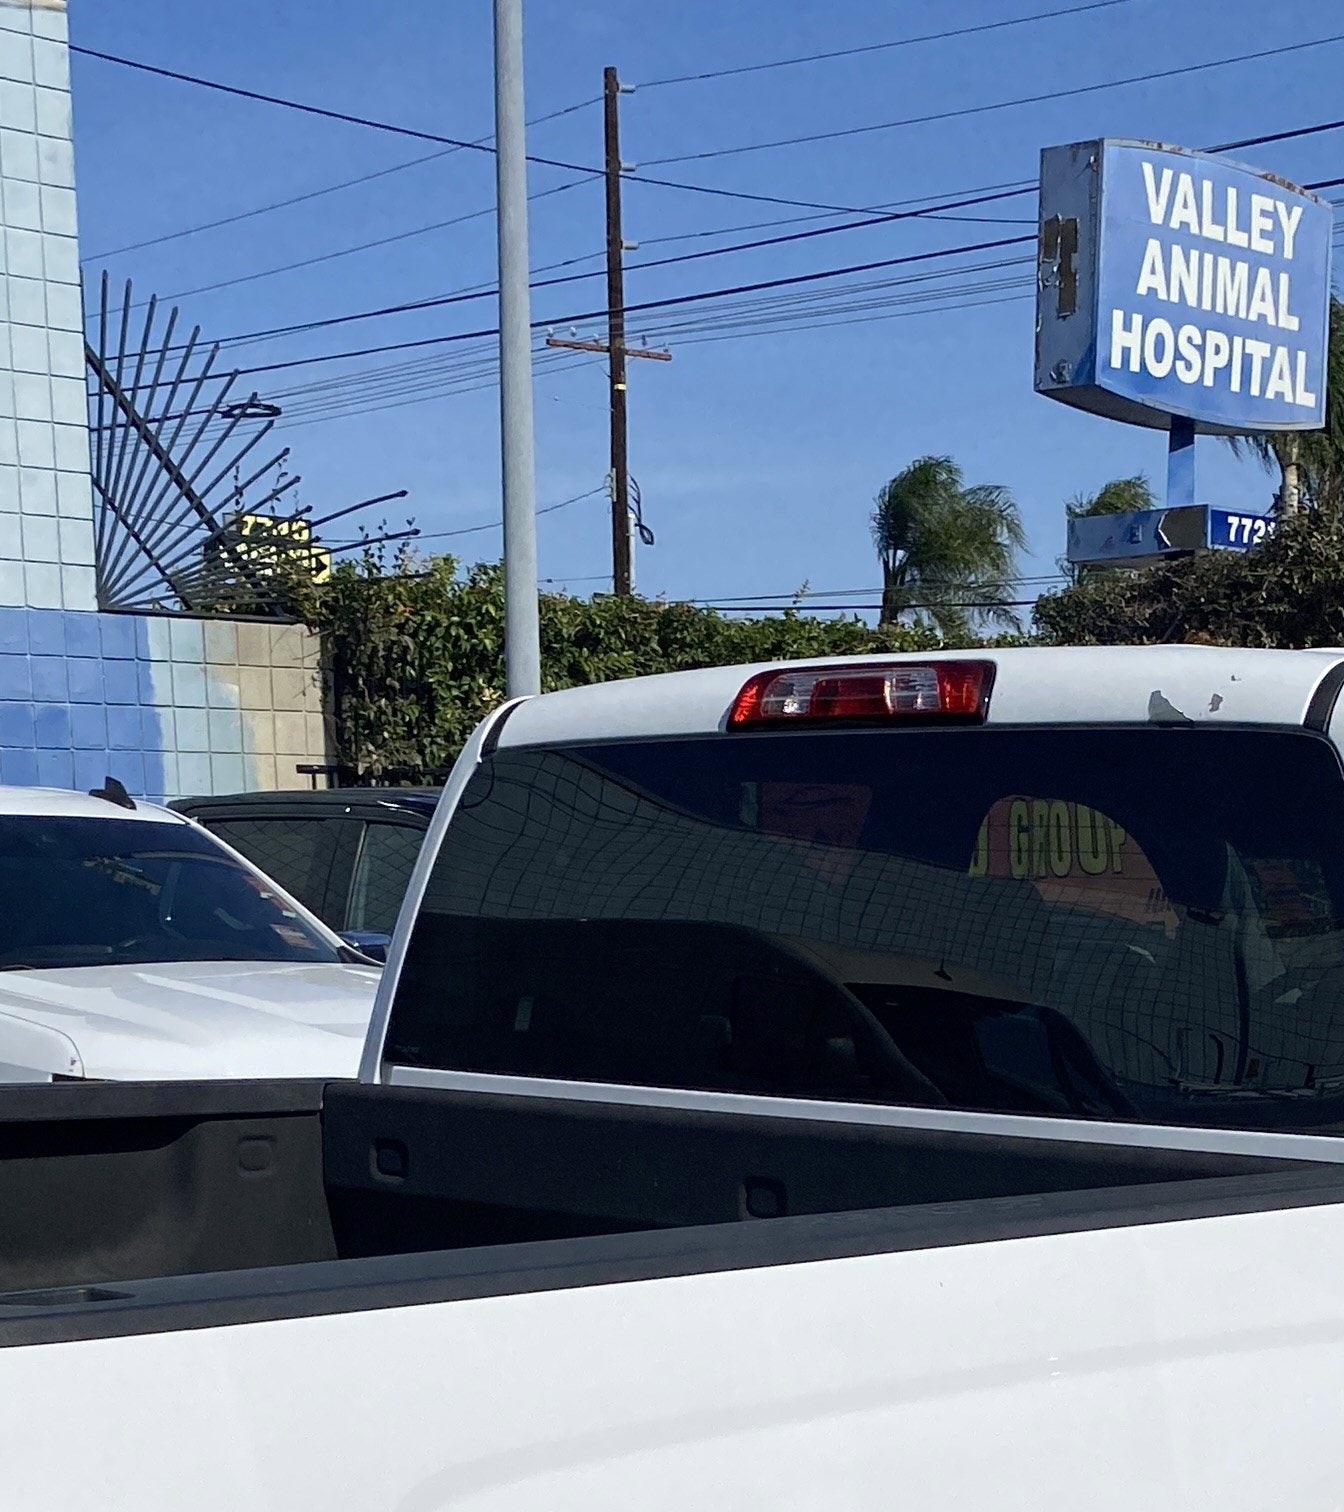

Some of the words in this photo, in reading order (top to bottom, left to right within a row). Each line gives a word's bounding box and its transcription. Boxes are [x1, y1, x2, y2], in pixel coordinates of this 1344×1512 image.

[1141, 161, 1303, 259] VALLEY
[1136, 238, 1300, 331] ANIMAL
[1110, 308, 1316, 408] HOSPITAL
[1009, 797, 1127, 879] GROUP
